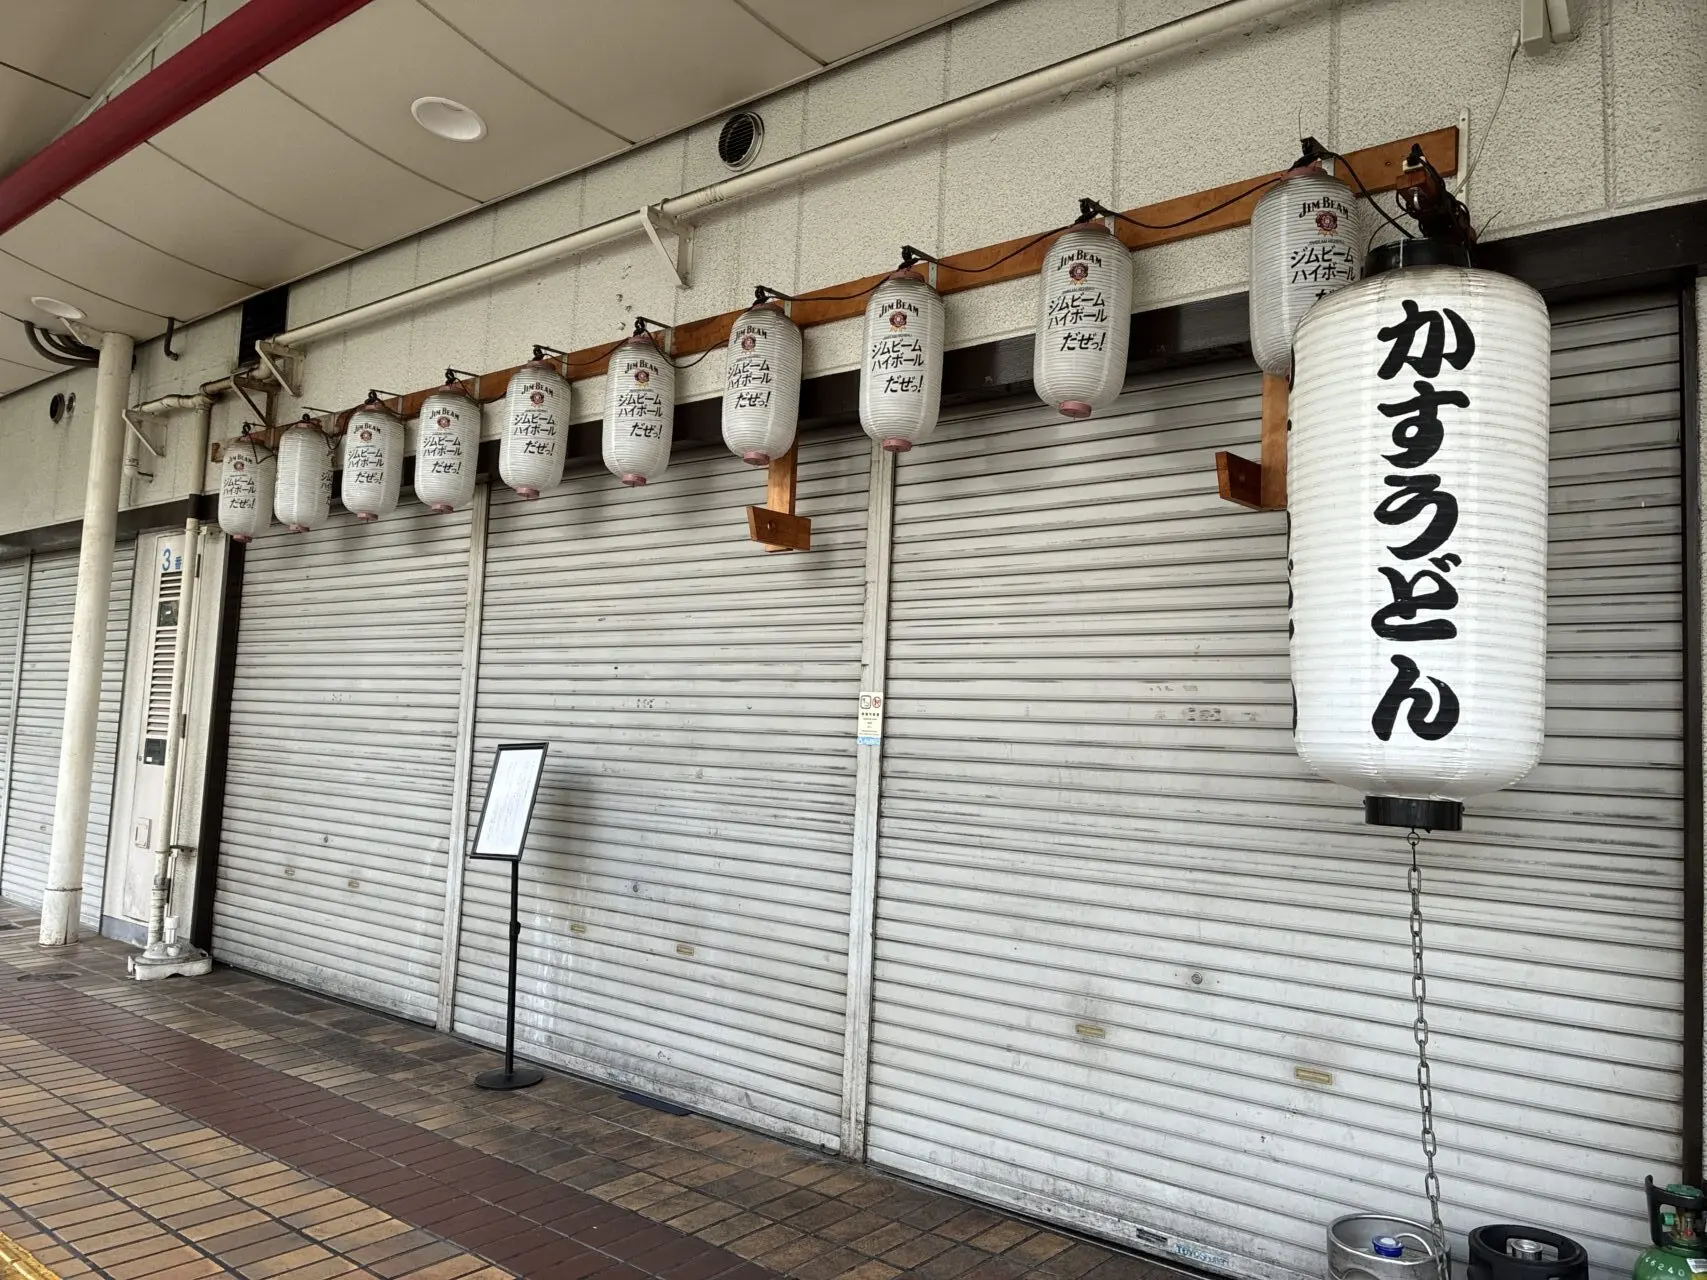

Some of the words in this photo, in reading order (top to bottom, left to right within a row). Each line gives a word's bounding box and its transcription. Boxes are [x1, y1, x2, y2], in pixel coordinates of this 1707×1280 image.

[1299, 201, 1320, 218] JIM
[1323, 197, 1348, 219] BEAM
[1058, 254, 1075, 270] JIM
[1077, 250, 1102, 267] BEAM
[1291, 246, 1354, 268] ジムビーム
[1292, 262, 1356, 283] ハイボール
[879, 303, 894, 318] JIM
[896, 299, 919, 317] BEAM
[1049, 292, 1105, 316] ジムビーム
[1048, 307, 1107, 329] ハイボール
[734, 329, 746, 344] JIM
[747, 325, 767, 339] BEAM
[1060, 332, 1106, 351] だぜっ!
[872, 339, 922, 359] ジムビーム
[625, 362, 638, 374] JIM
[640, 360, 659, 376] BEAM
[728, 359, 770, 380] ジムビーム
[872, 352, 924, 372] ハイボール
[521, 384, 534, 394] JIM
[536, 382, 554, 397] BEAM
[728, 372, 772, 391] ハイボール
[884, 375, 924, 393] だぜっ!
[618, 393, 662, 406] ジムビーム
[735, 391, 771, 409] だぜっ!
[514, 413, 555, 425] ジムビーム
[618, 404, 663, 417] ハイボール
[514, 424, 556, 436] ハイボール
[630, 422, 662, 439] だぜっ!
[424, 436, 460, 448] ジムビーム
[524, 440, 555, 456] だぜっ!
[348, 448, 382, 460] ジムビーム
[424, 446, 462, 457] ハイボール
[348, 458, 384, 469] ハイボール
[432, 461, 461, 474] だぜっ!
[355, 472, 384, 484] だぜっ!
[1371, 299, 1476, 741] かすうどん
